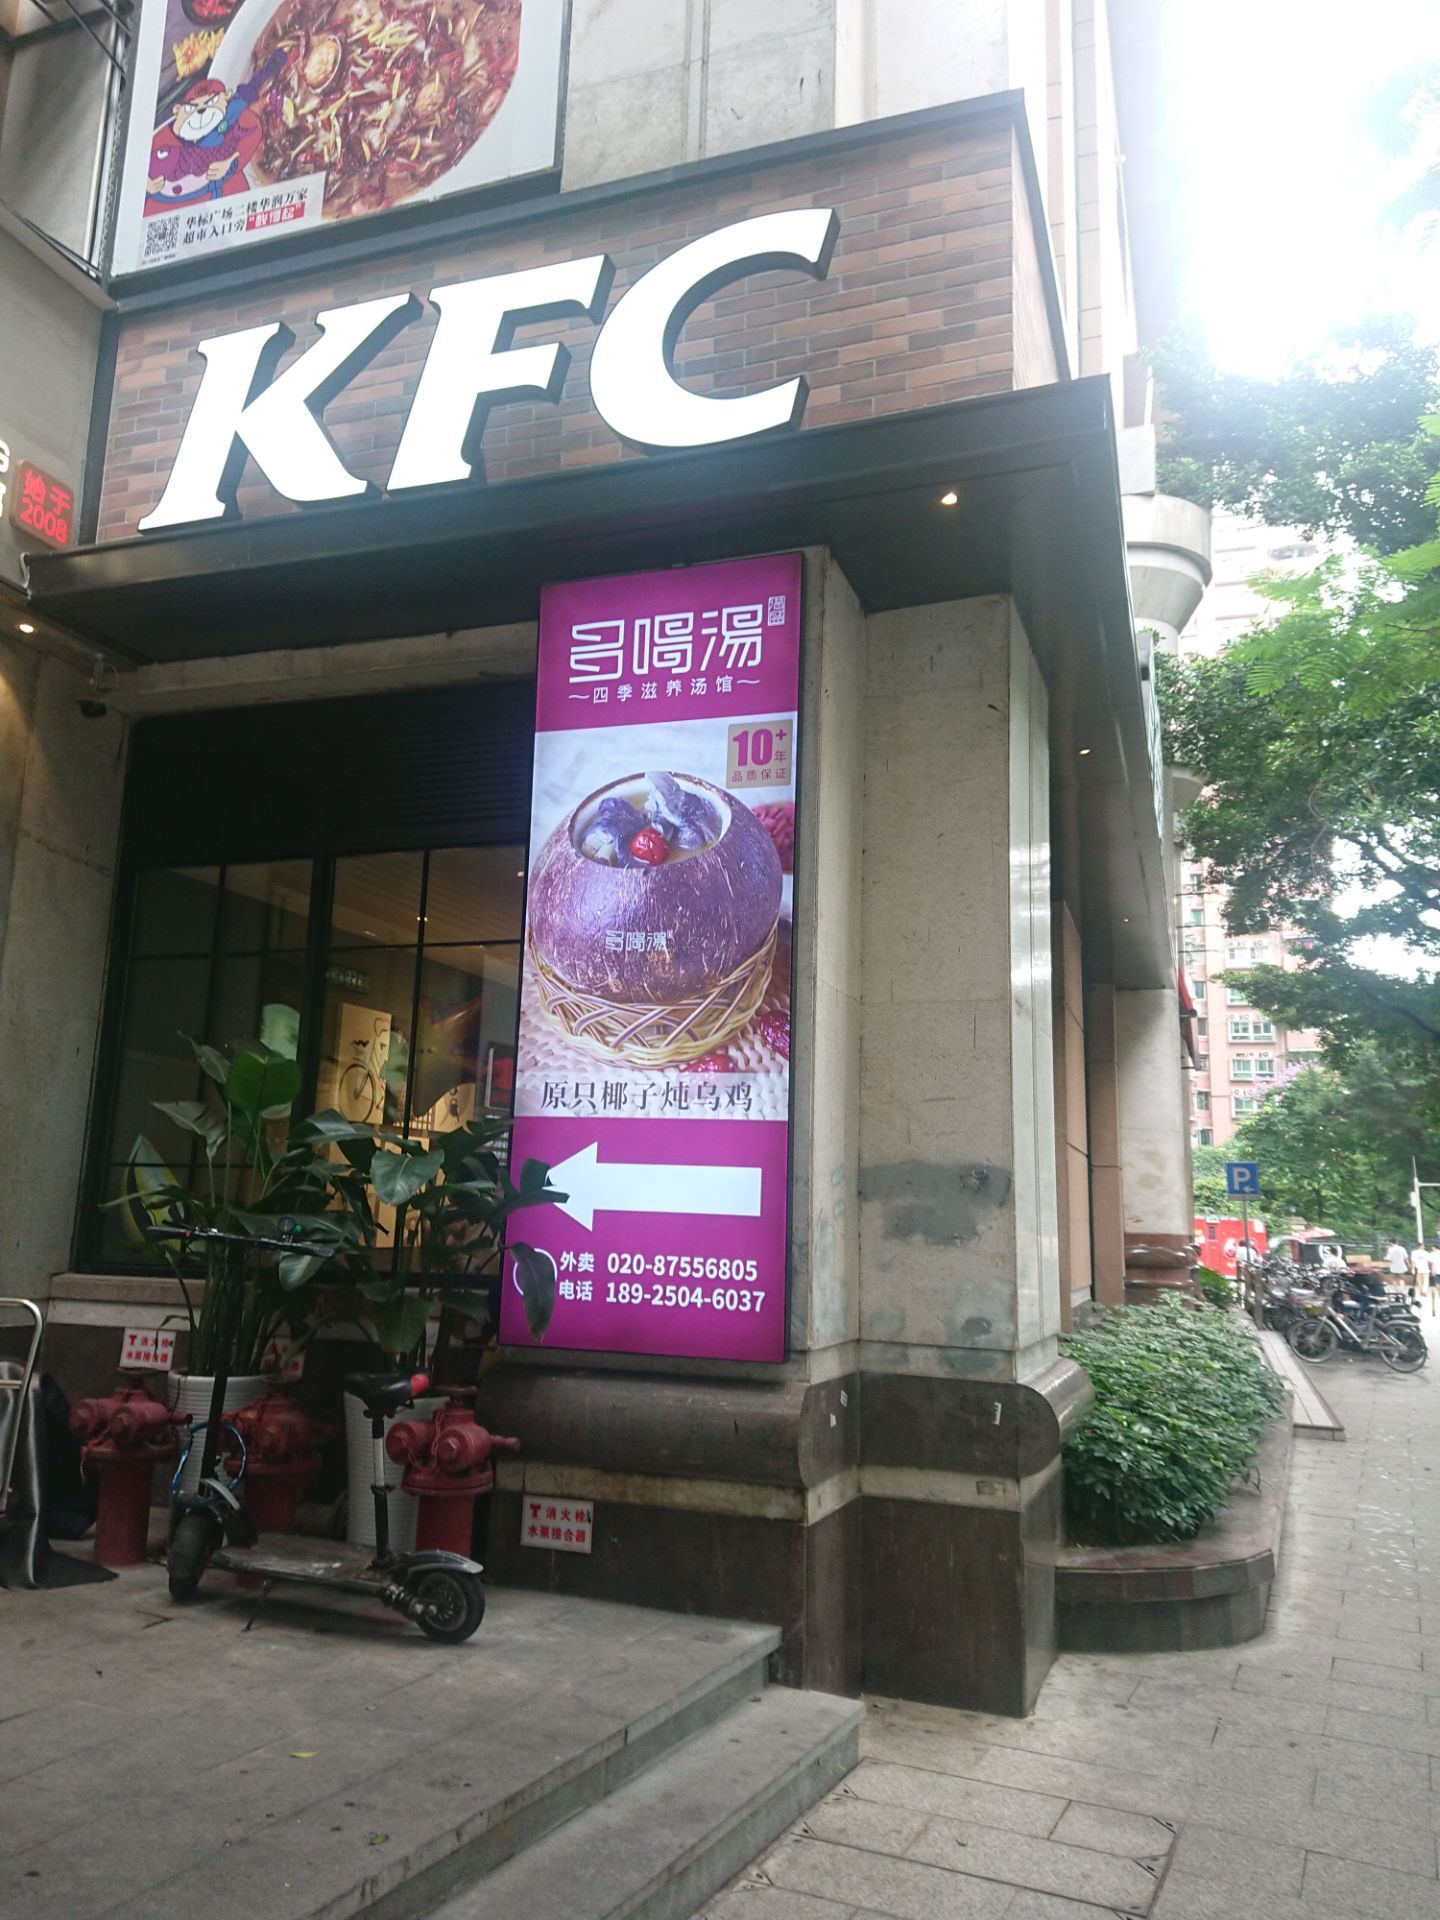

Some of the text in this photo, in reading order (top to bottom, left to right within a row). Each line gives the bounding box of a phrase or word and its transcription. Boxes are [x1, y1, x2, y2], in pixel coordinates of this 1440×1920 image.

[137, 207, 834, 531] KFC
[21, 498, 68, 543] 2008
[592, 675, 734, 703] 四季滋养汤馆
[731, 768, 787, 782] 品质保证
[541, 1080, 753, 1113] 原只椰子炖乌鸡
[1233, 1167, 1251, 1190] P
[560, 1251, 758, 1281] 外卖 020-87556805
[558, 1280, 766, 1312] 电话 189-2504-6037
